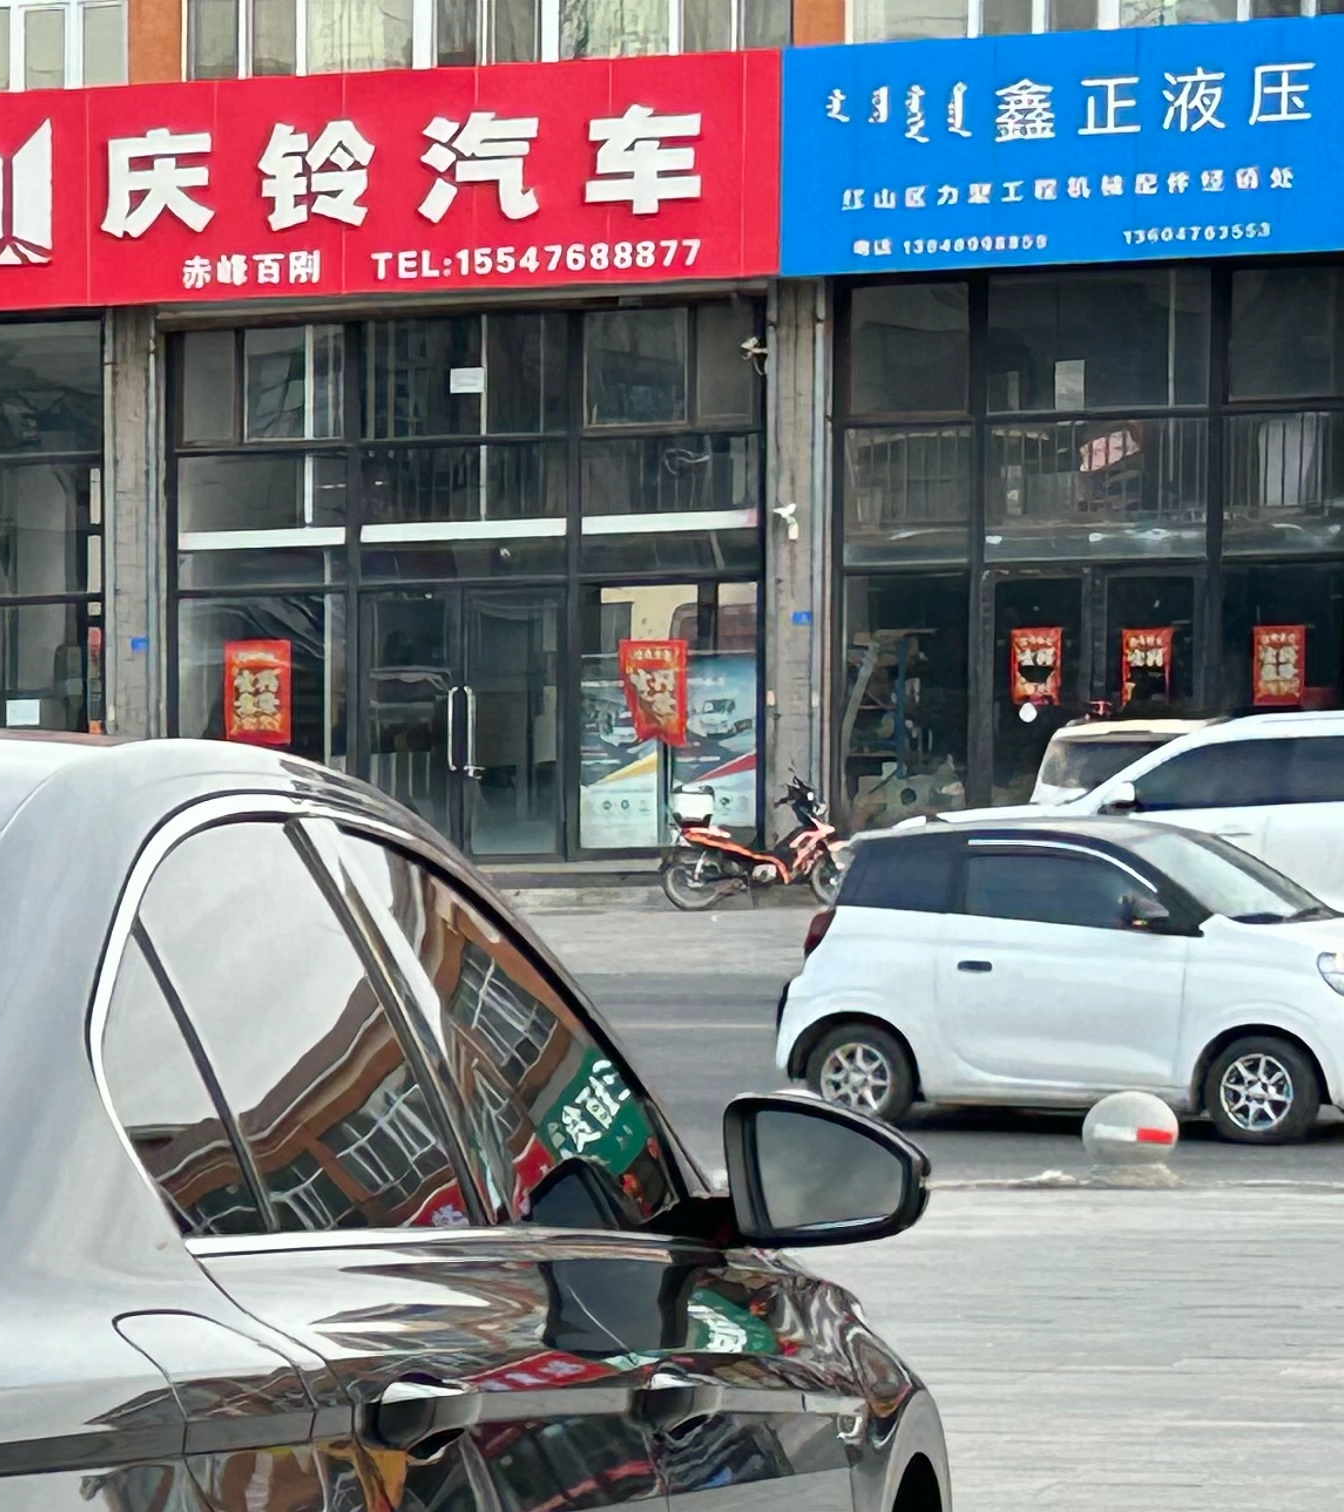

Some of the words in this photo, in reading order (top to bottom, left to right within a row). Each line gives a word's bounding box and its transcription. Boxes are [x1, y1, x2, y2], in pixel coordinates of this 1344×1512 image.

[995, 62, 1316, 142] 鑫正液压
[100, 104, 702, 239] 庆铃汽车
[370, 238, 702, 281] TEL:15547688877
